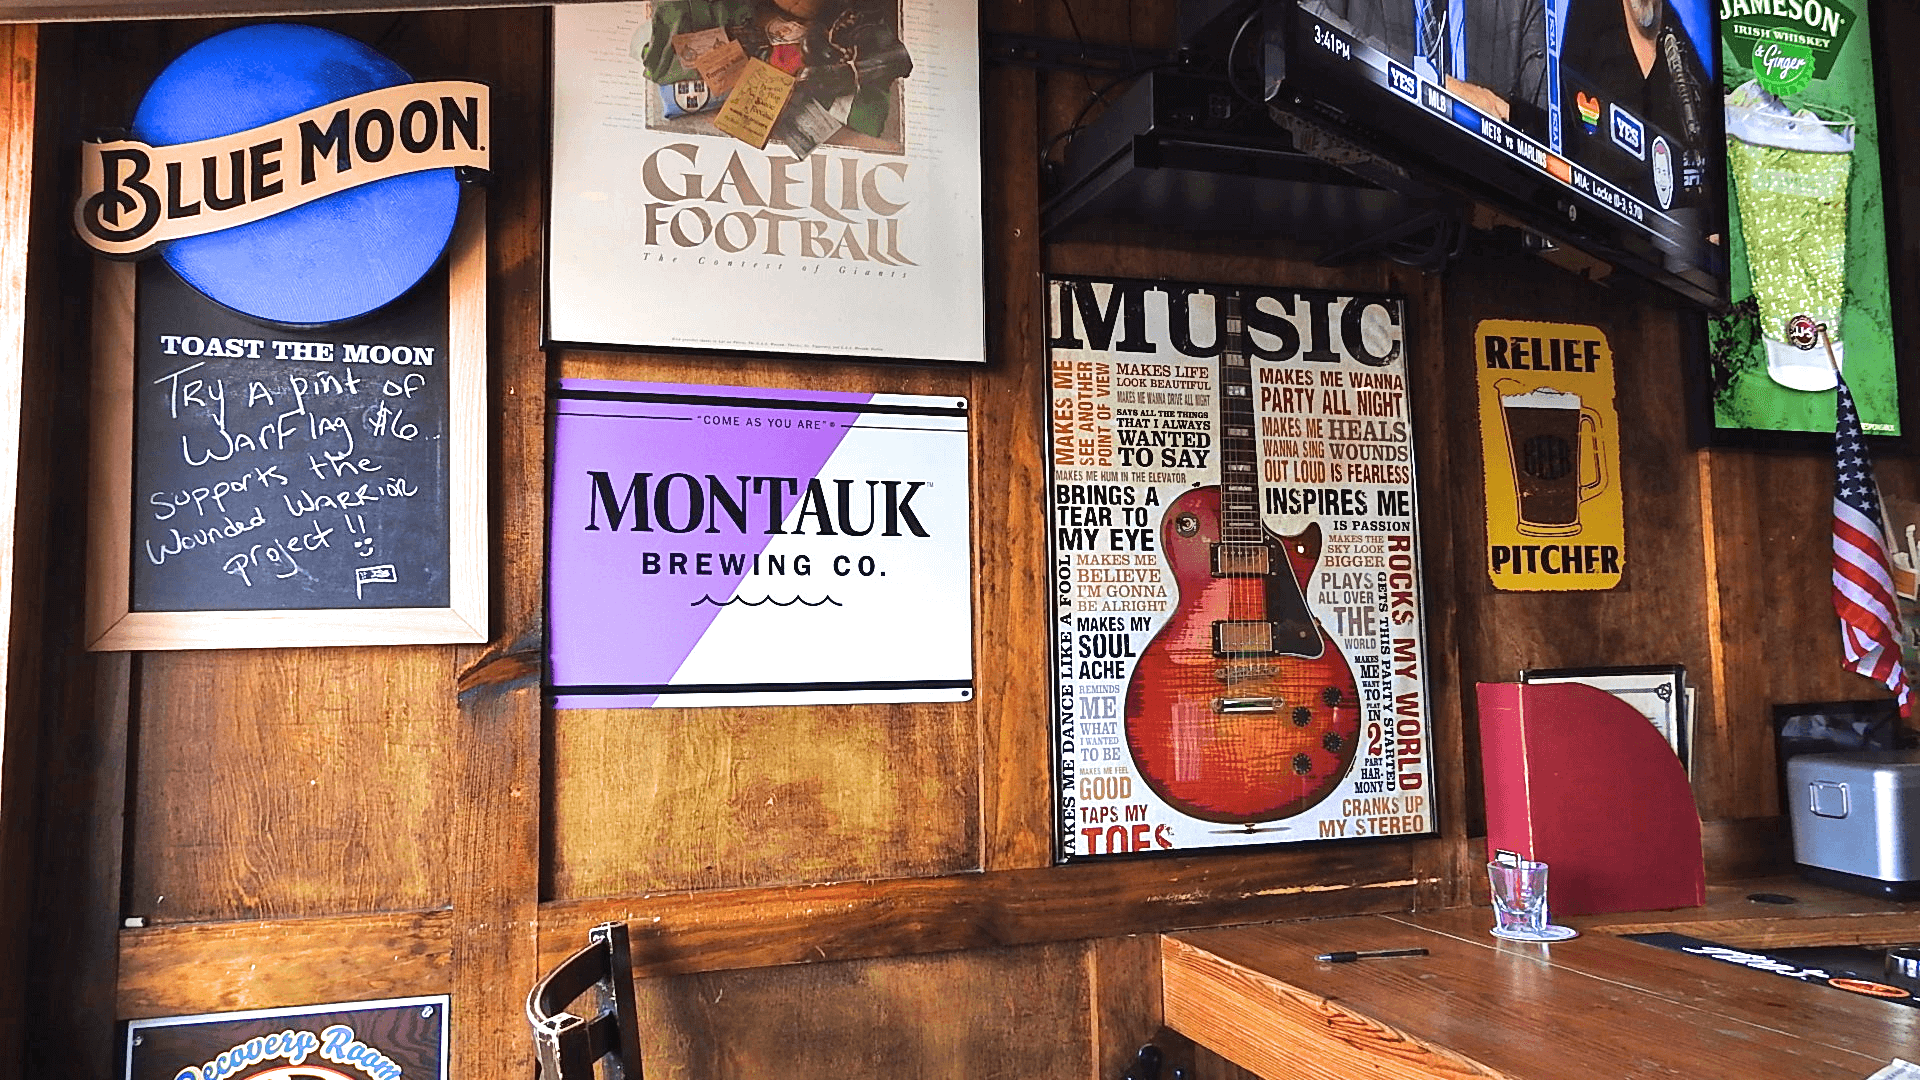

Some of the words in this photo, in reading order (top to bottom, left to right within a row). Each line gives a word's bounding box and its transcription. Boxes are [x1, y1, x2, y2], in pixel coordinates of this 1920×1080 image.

[1314, 25, 1350, 60] 3:41PM
[1733, 24, 1771, 39] IRISH
[1773, 30, 1831, 48] WHISKEY
[1754, 45, 1764, 57] &
[1763, 44, 1806, 80] Ginger
[1391, 67, 1415, 95] YES
[1429, 88, 1447, 113] MLB
[1481, 118, 1502, 143] METS
[1616, 117, 1639, 147] YES
[83, 138, 284, 242] BLUE
[642, 143, 912, 224] GAELIC
[1593, 180, 1612, 203] Locke
[644, 202, 920, 266] FOOTBALL
[643, 252, 678, 263] The
[698, 256, 783, 270] Contest
[839, 265, 908, 279] Giants
[1049, 282, 1401, 367] MUSIC
[160, 335, 264, 359] TOAST
[272, 340, 334, 362] THE
[342, 344, 435, 366] MOON
[1484, 335, 1600, 373] RELIEF
[1053, 360, 1073, 390] ME
[1096, 362, 1110, 398] VIEW
[1116, 362, 1172, 378] MAKES
[1175, 365, 1209, 379] LIFE
[1259, 367, 1314, 386] MAKES
[1320, 370, 1344, 388] ME
[1348, 371, 1404, 391] WANNA
[289, 366, 361, 416] pint
[1116, 377, 1147, 388] LOOK
[1150, 378, 1212, 391] BEAUTIFUL
[1077, 361, 1094, 433] ANOTHER
[1261, 386, 1315, 414] PARTY
[1322, 389, 1351, 416] ALL
[1356, 390, 1403, 418] NIGHT
[745, 417, 762, 427] AS
[767, 418, 792, 429] YOU
[1097, 403, 1111, 420] OF
[1116, 408, 1139, 417] SAYS
[1140, 409, 1157, 417] ALL
[1157, 410, 1176, 418] THE
[1176, 410, 1209, 419] THINGS
[1055, 397, 1075, 466] MAKES
[1116, 417, 1151, 429] THAT
[1161, 419, 1211, 431] ALWAYS
[1261, 416, 1302, 438] MAKES
[1306, 418, 1324, 439] ME
[1327, 419, 1408, 443] HEALS
[1097, 425, 1112, 466] POINT
[1116, 429, 1211, 449] WANTED
[1262, 438, 1300, 458] WANNA
[1302, 440, 1325, 459] SING
[1078, 438, 1095, 466] SEE
[1117, 447, 1154, 468] TO
[1161, 447, 1211, 469] SAY
[1328, 443, 1409, 462] WOUNDS
[308, 453, 383, 480] the
[1055, 470, 1084, 482] MAKES
[1086, 470, 1098, 482] ME
[1100, 471, 1119, 482] HUM
[1131, 471, 1146, 483] THE
[1148, 472, 1187, 484] ELEVATOR
[1264, 458, 1289, 483] OUT
[1293, 460, 1326, 484] LOUD
[1330, 462, 1343, 483] IS
[1347, 463, 1410, 485] FEARLESS
[584, 470, 931, 538] MONTAUK
[1056, 484, 1136, 506] BRINGS
[1144, 486, 1160, 507] A
[1265, 487, 1368, 516] INSPIRES
[1376, 490, 1410, 517] ME
[1057, 505, 1112, 527] TEAR
[1121, 506, 1148, 527] TO
[1333, 520, 1348, 531] IS
[1352, 521, 1411, 532] PASSION
[1058, 527, 1099, 551] MY
[1109, 528, 1155, 551] EYE
[1327, 544, 1352, 554] SKY
[1354, 545, 1385, 554] LOOK
[1328, 535, 1363, 543] MAKES
[1365, 535, 1384, 544] THE
[642, 552, 811, 576] BREWING
[833, 555, 886, 577] CO.
[1076, 554, 1131, 566] MAKES
[1134, 554, 1157, 566] ME
[1324, 555, 1386, 568] BIGGER
[1491, 544, 1620, 576] PITCHER
[1058, 554, 1072, 607] FOOL
[1076, 568, 1161, 583] BELIEVE
[1321, 572, 1374, 590] PLAYS
[1387, 535, 1415, 626] ROCKS
[1076, 585, 1102, 598] I'M
[1106, 585, 1168, 598] GONNA
[1318, 591, 1339, 605] ALL
[1343, 590, 1374, 605] OVER
[1377, 571, 1389, 613] GETS
[1076, 601, 1098, 612] BE
[1101, 600, 1168, 612] ALRIGHT
[1077, 616, 1126, 632] MAKES
[1130, 616, 1152, 632] MY
[1333, 605, 1377, 637] THE
[1078, 633, 1137, 659] SOUL
[1344, 638, 1377, 650] WORLD
[1379, 616, 1391, 656] THIS
[1060, 631, 1073, 680] LIKE
[1354, 655, 1379, 664] MAKES
[1392, 638, 1418, 681] MY
[1078, 660, 1126, 680] ACHE
[1360, 664, 1380, 679] ME
[1079, 684, 1121, 695] REMINDS
[1364, 689, 1381, 701] TO
[1381, 659, 1393, 713] PARTY
[1061, 684, 1074, 755] DANCE
[1079, 696, 1117, 720] ME
[1367, 709, 1381, 722] IN
[1079, 722, 1118, 735] WHAT
[1367, 722, 1383, 757] 2
[1084, 736, 1120, 746] WANTED
[1395, 691, 1423, 791] WORLD
[1080, 747, 1100, 762] TO
[1103, 747, 1121, 761] BE
[1364, 758, 1383, 767] PART
[1383, 717, 1396, 792] STARTED
[1062, 759, 1075, 791] ME
[1079, 775, 1132, 801] GOOD
[1354, 781, 1384, 794] MONY
[1080, 805, 1119, 825] TAPS
[1125, 804, 1149, 822] MY
[1342, 796, 1400, 818] CRANKS
[1404, 795, 1424, 814] UP
[1318, 818, 1348, 838] MY
[1355, 814, 1424, 836] STEREO
[325, 1027, 401, 1080] Room
